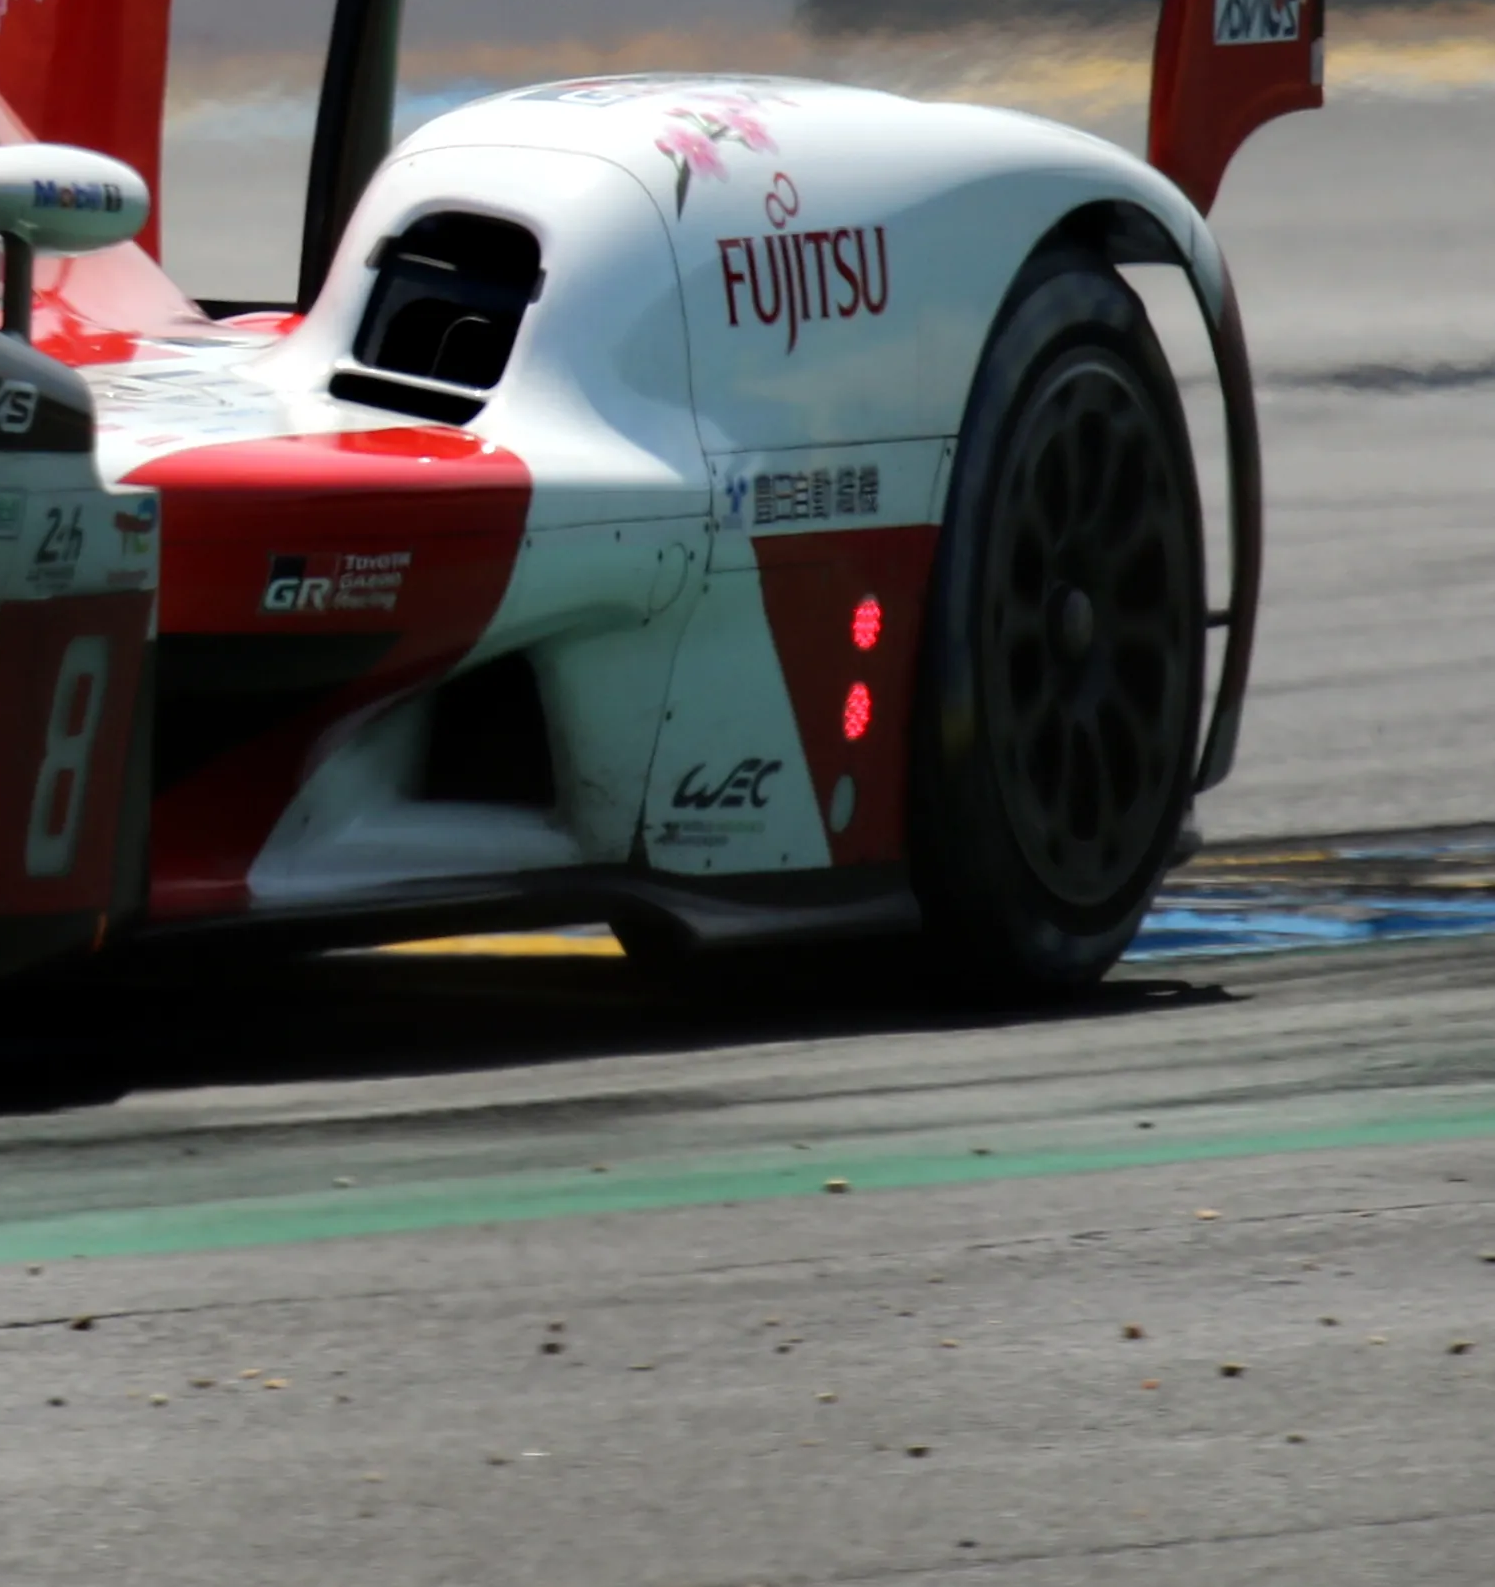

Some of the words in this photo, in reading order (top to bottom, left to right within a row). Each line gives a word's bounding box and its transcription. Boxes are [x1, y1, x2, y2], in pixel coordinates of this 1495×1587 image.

[716, 225, 889, 357] FUJITSU
[263, 576, 334, 611] GR
[25, 635, 109, 877] 8
[671, 756, 783, 810] WEC
